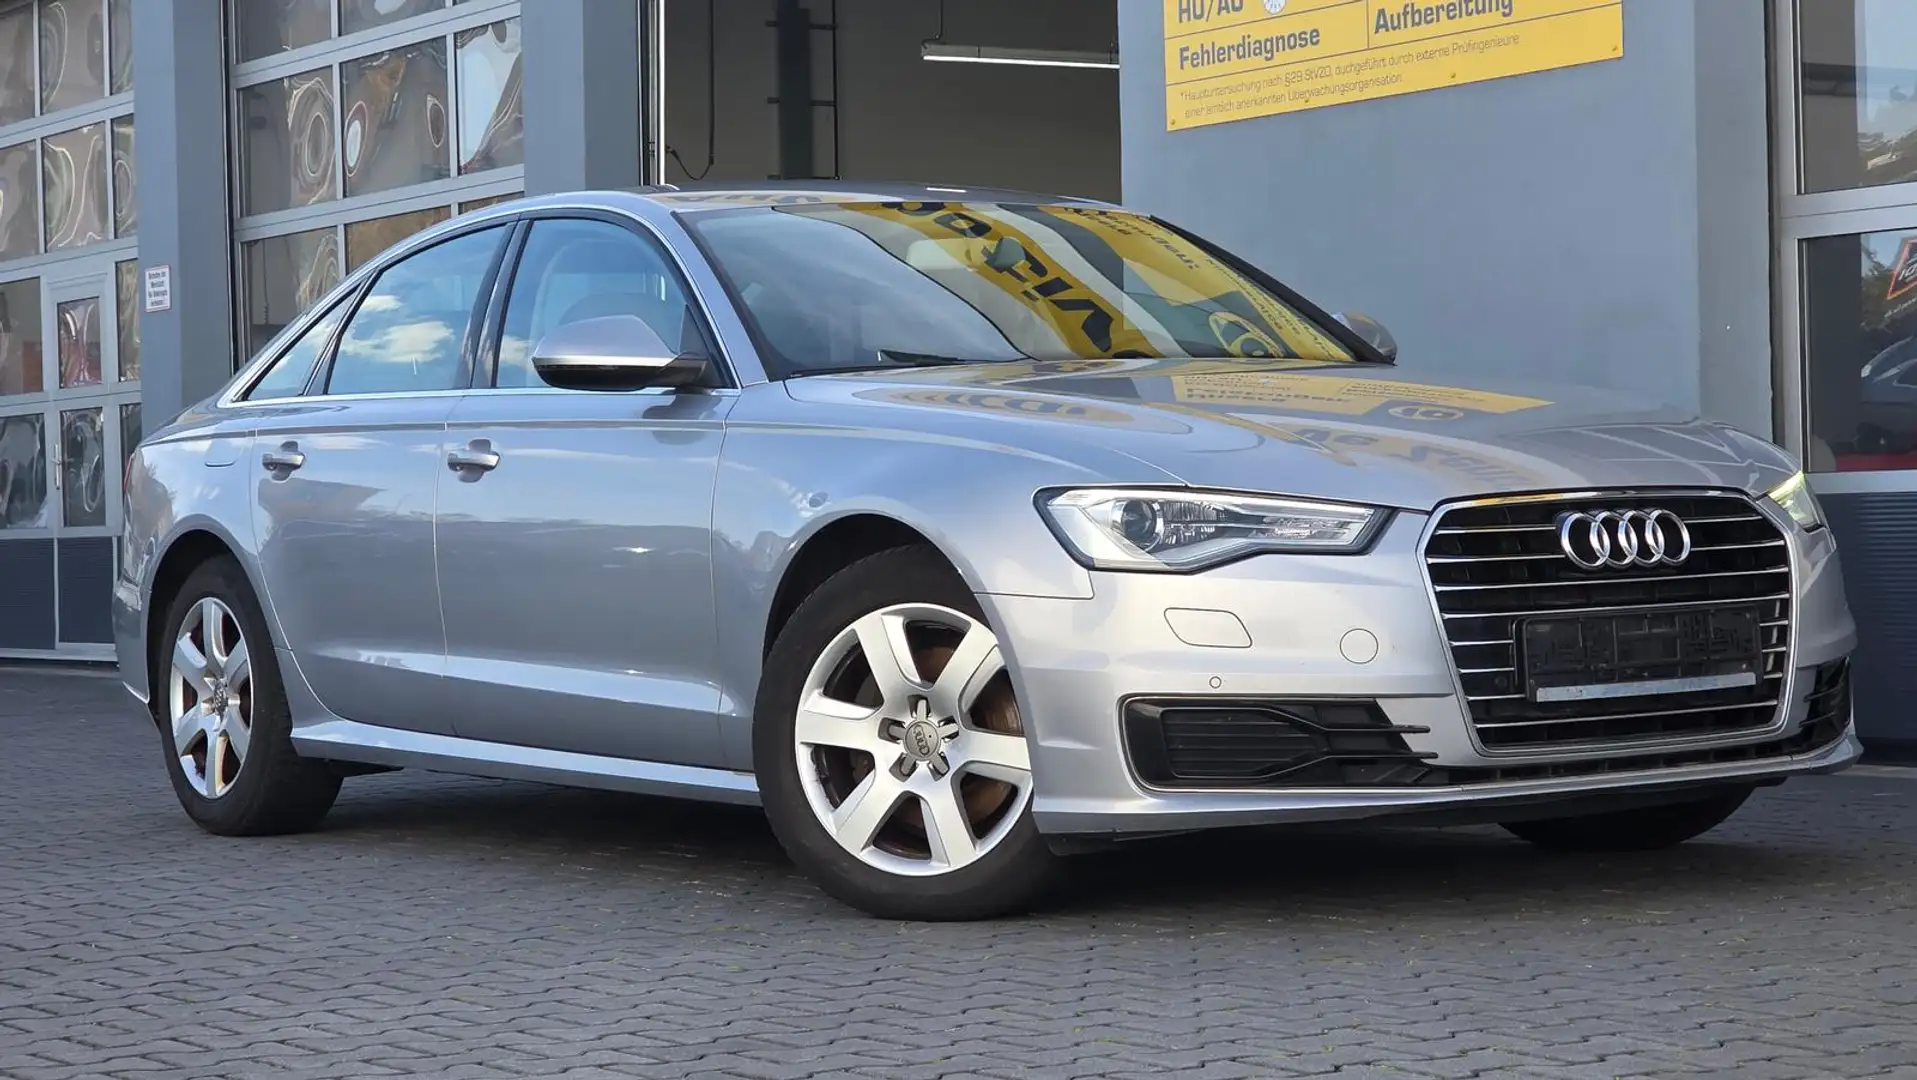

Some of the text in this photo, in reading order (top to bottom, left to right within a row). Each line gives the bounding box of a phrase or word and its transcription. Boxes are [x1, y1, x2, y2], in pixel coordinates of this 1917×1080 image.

[1374, 0, 1513, 34] Aufbereitung
[1179, 28, 1320, 70] Fehlerdiagnose
[1263, 75, 1283, 88] nach
[1388, 51, 1414, 65] durch
[1416, 46, 1450, 61] externe
[1184, 106, 1205, 118] einer
[1236, 93, 1287, 109] anerkannten
